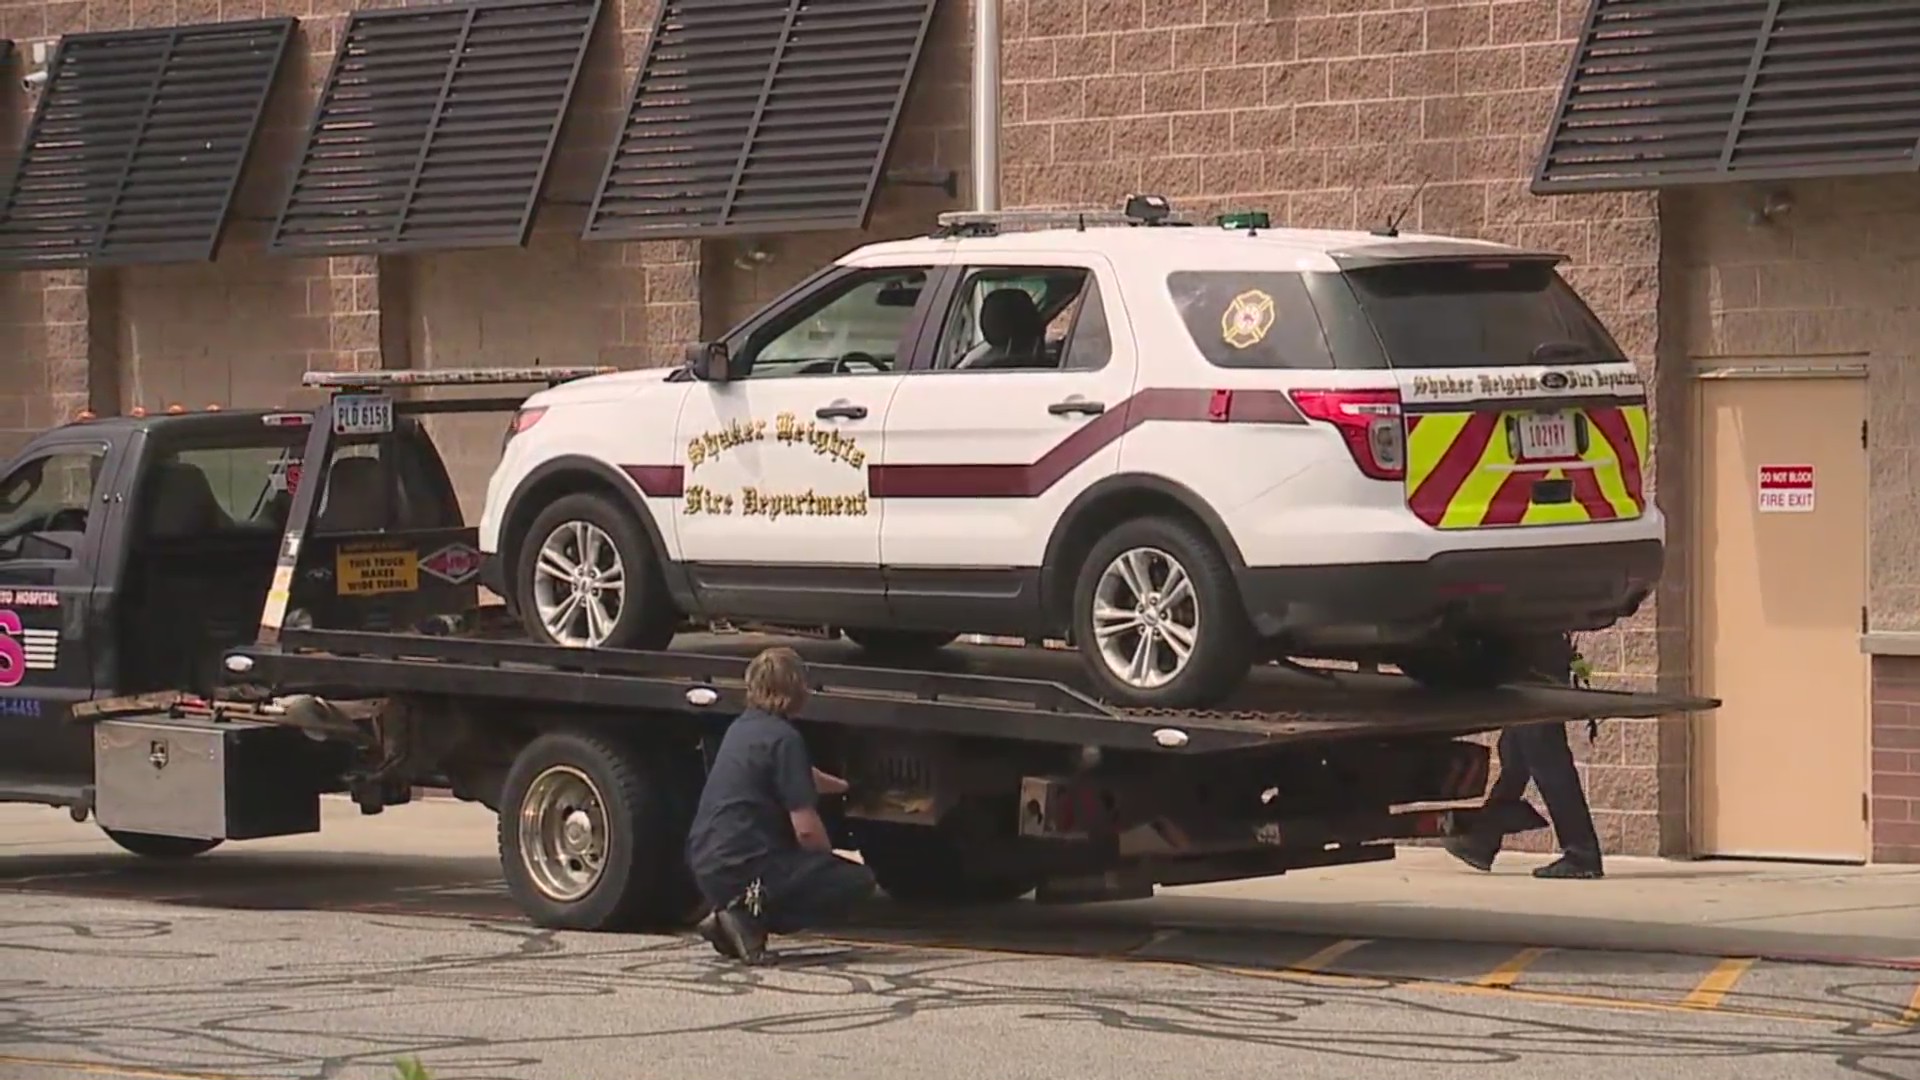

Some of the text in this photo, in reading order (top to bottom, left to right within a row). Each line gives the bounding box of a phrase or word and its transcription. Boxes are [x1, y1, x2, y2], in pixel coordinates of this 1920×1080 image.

[687, 411, 866, 472] Shaker Heights
[683, 485, 868, 522] Fire Department
[1761, 493, 1812, 506] FIRE EXIT
[349, 557, 405, 569] THIS TRUCK
[361, 568, 395, 578] MAKES
[347, 578, 408, 591] WIDE TURNS
[15, 591, 59, 606] HOSPITAL
